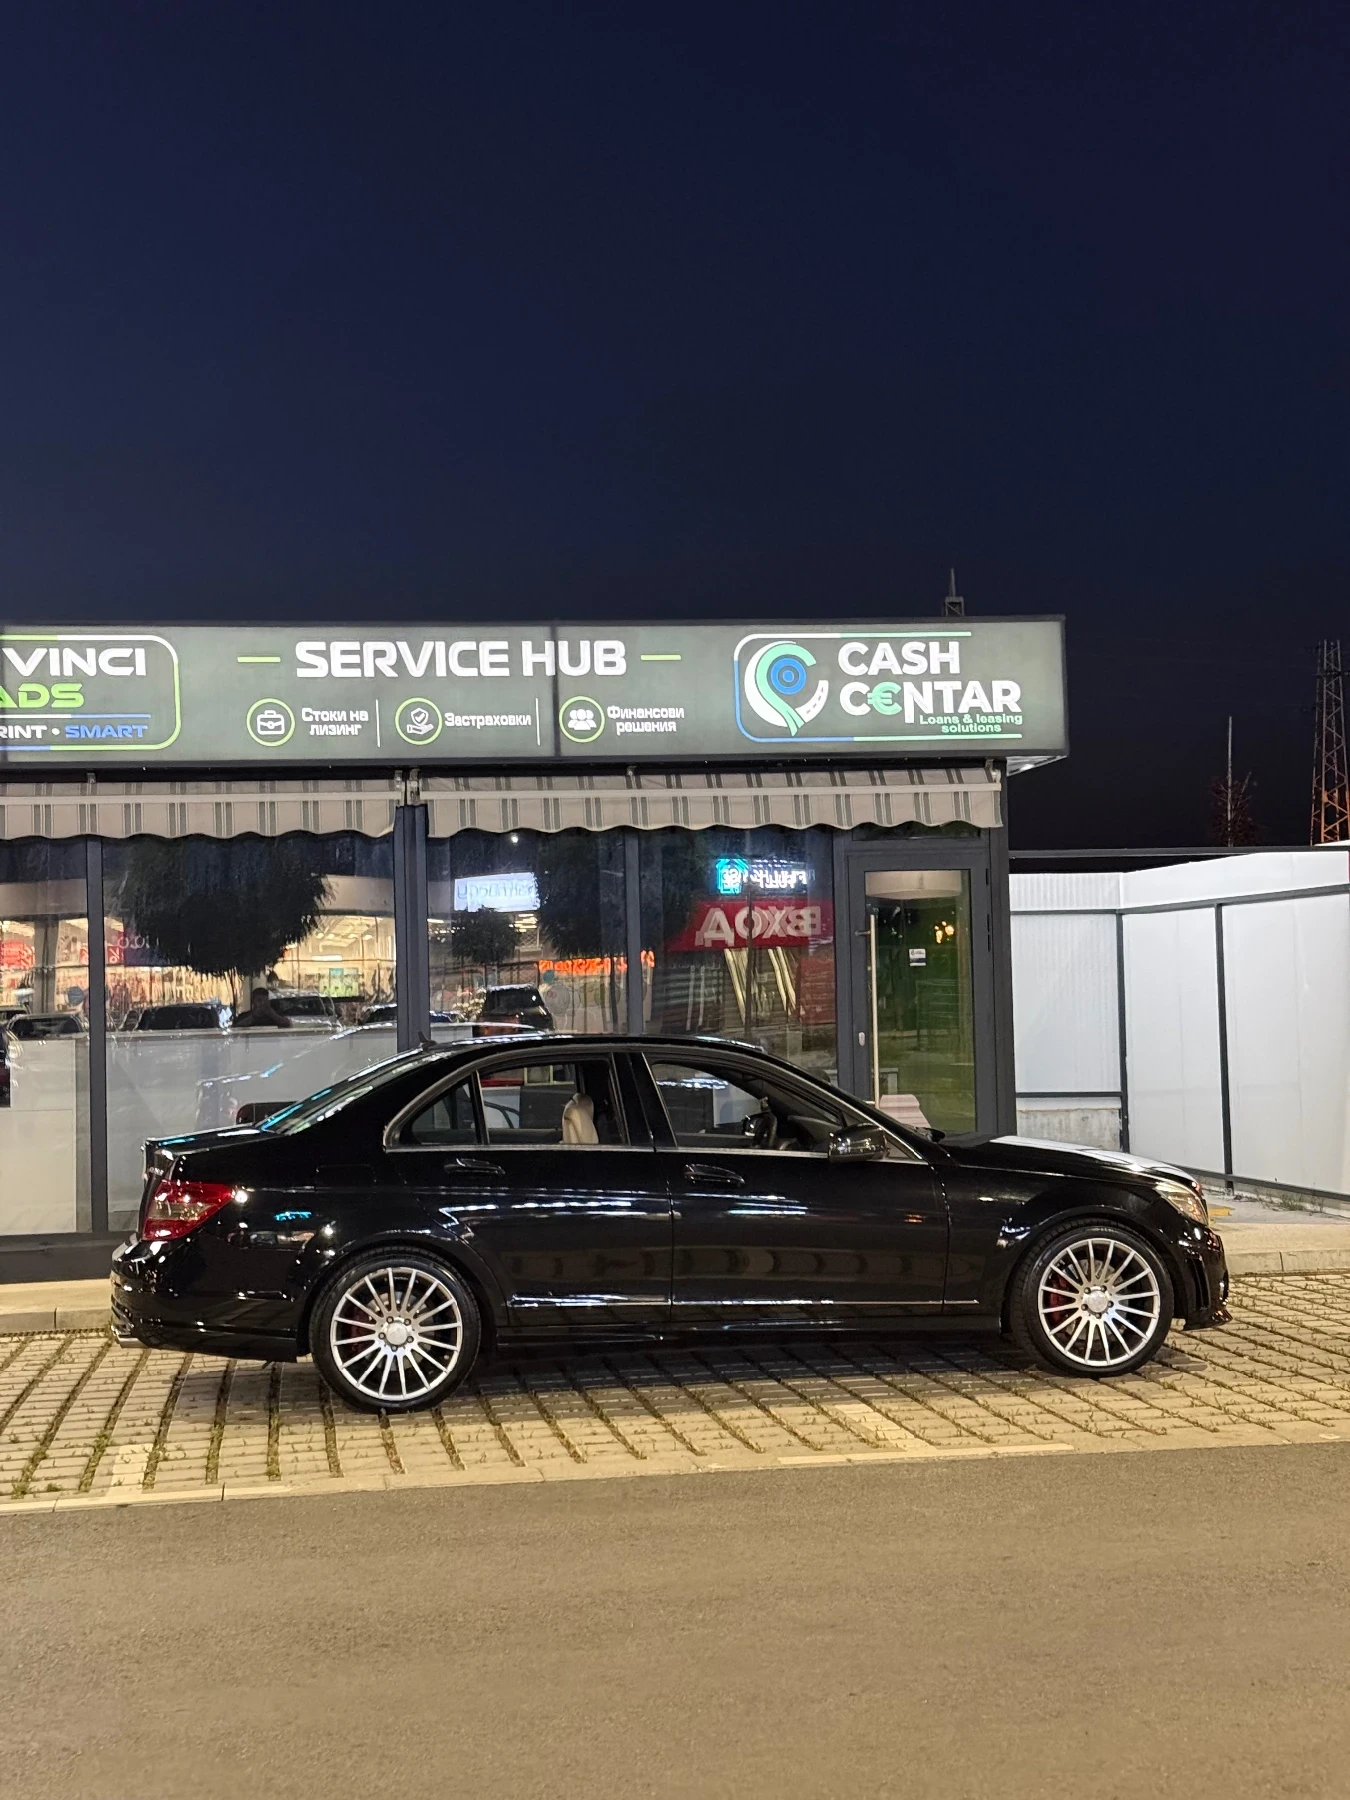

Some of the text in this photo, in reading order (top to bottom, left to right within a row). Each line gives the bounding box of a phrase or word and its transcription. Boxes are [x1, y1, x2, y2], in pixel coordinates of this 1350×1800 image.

[3, 647, 147, 677] VINCI
[295, 640, 627, 678] SERVICE HUB
[838, 641, 961, 676] CASH
[301, 707, 369, 722] Стоки на
[606, 705, 685, 720] Финансови
[919, 713, 1023, 725] Loans & leasing
[444, 712, 532, 729] Застраховки
[941, 722, 1002, 734] solutions
[65, 724, 148, 739] SMART
[309, 723, 362, 736] лизинг
[615, 721, 677, 736] решения
